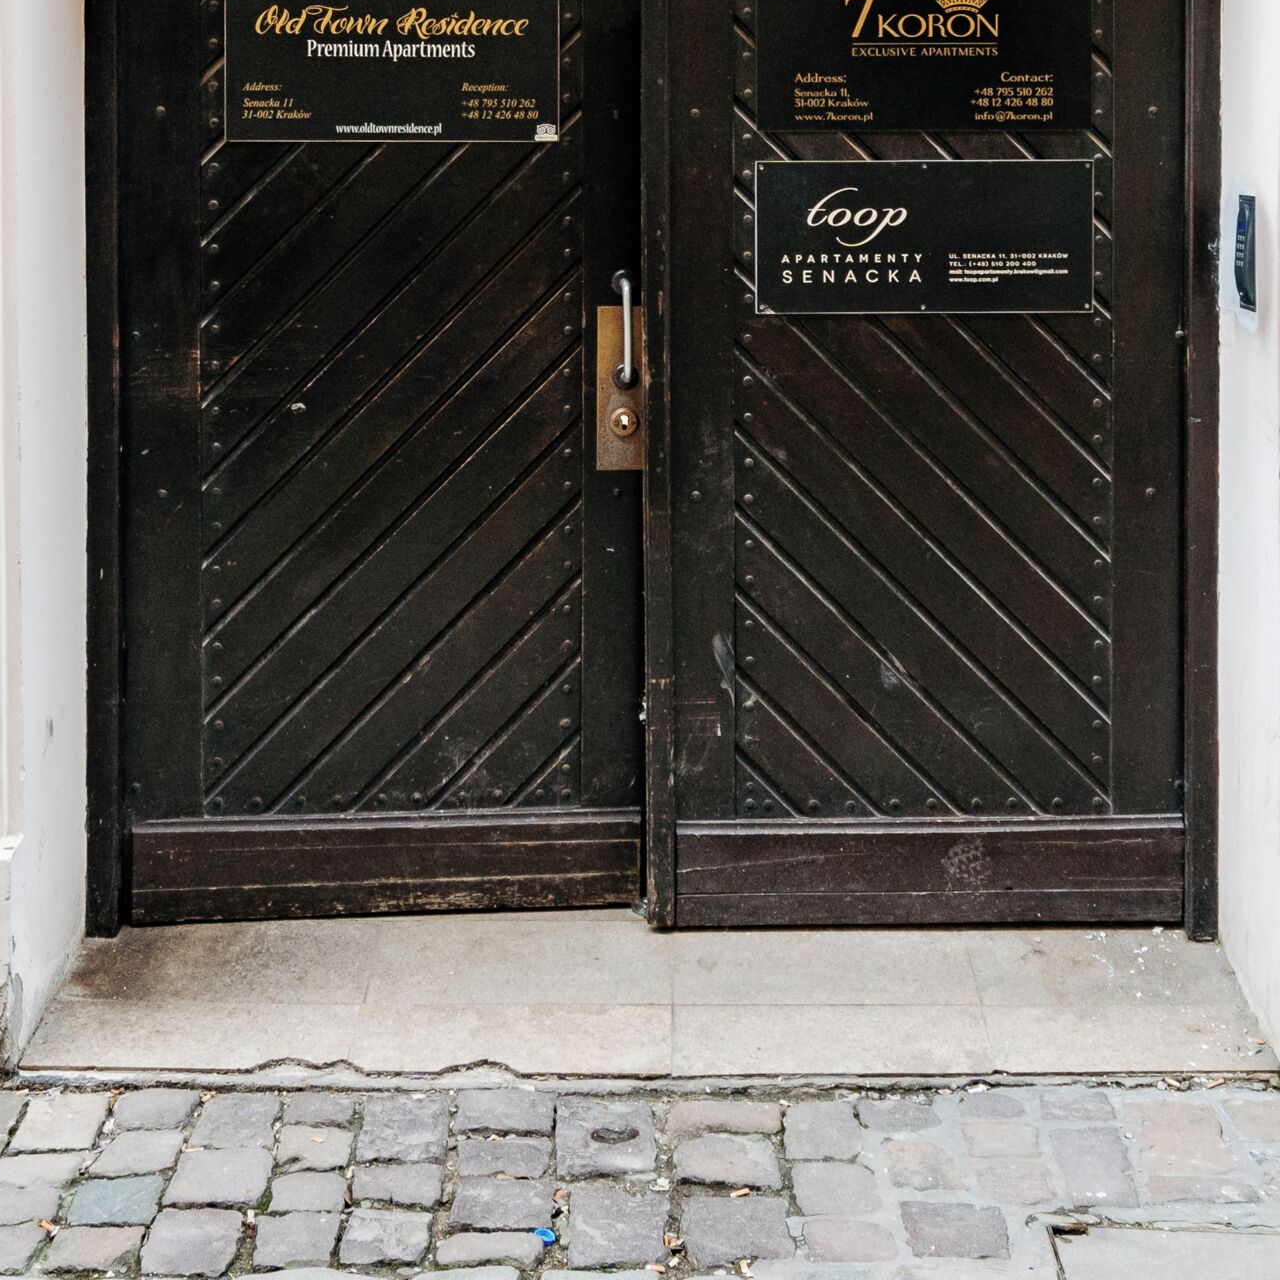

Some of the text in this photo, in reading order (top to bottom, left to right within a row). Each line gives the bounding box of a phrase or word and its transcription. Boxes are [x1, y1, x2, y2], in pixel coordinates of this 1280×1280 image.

[255, 4, 529, 39] Old Town Residence
[307, 39, 476, 62] Premium Apartments
[851, 46, 999, 57] EXCLUSIVE APARTMENTS
[794, 72, 847, 83] Address:
[1000, 71, 1054, 83] Contact:
[242, 81, 283, 92] Address:
[461, 82, 509, 94] Reception:
[974, 87, 1054, 97] +48 795 510 262
[794, 88, 837, 97] Senacka
[243, 97, 294, 108] Senacka 11
[461, 98, 537, 109] +48 795 510 262
[794, 98, 870, 108] 31-002 Kraków
[969, 97, 1054, 107] +48 12 426 48 80
[241, 108, 312, 119] 31-002 Kraków
[461, 110, 539, 120] +48 12 426 48 80
[794, 111, 874, 122] www.7koron.pl
[974, 110, 1054, 122] info@7koron.pl
[335, 122, 442, 136] www.oldtownresidence.pl
[781, 253, 923, 264] APARTAMENTY
[1038, 252, 1069, 260] KRAKÓW
[782, 270, 923, 284] SENACKA
